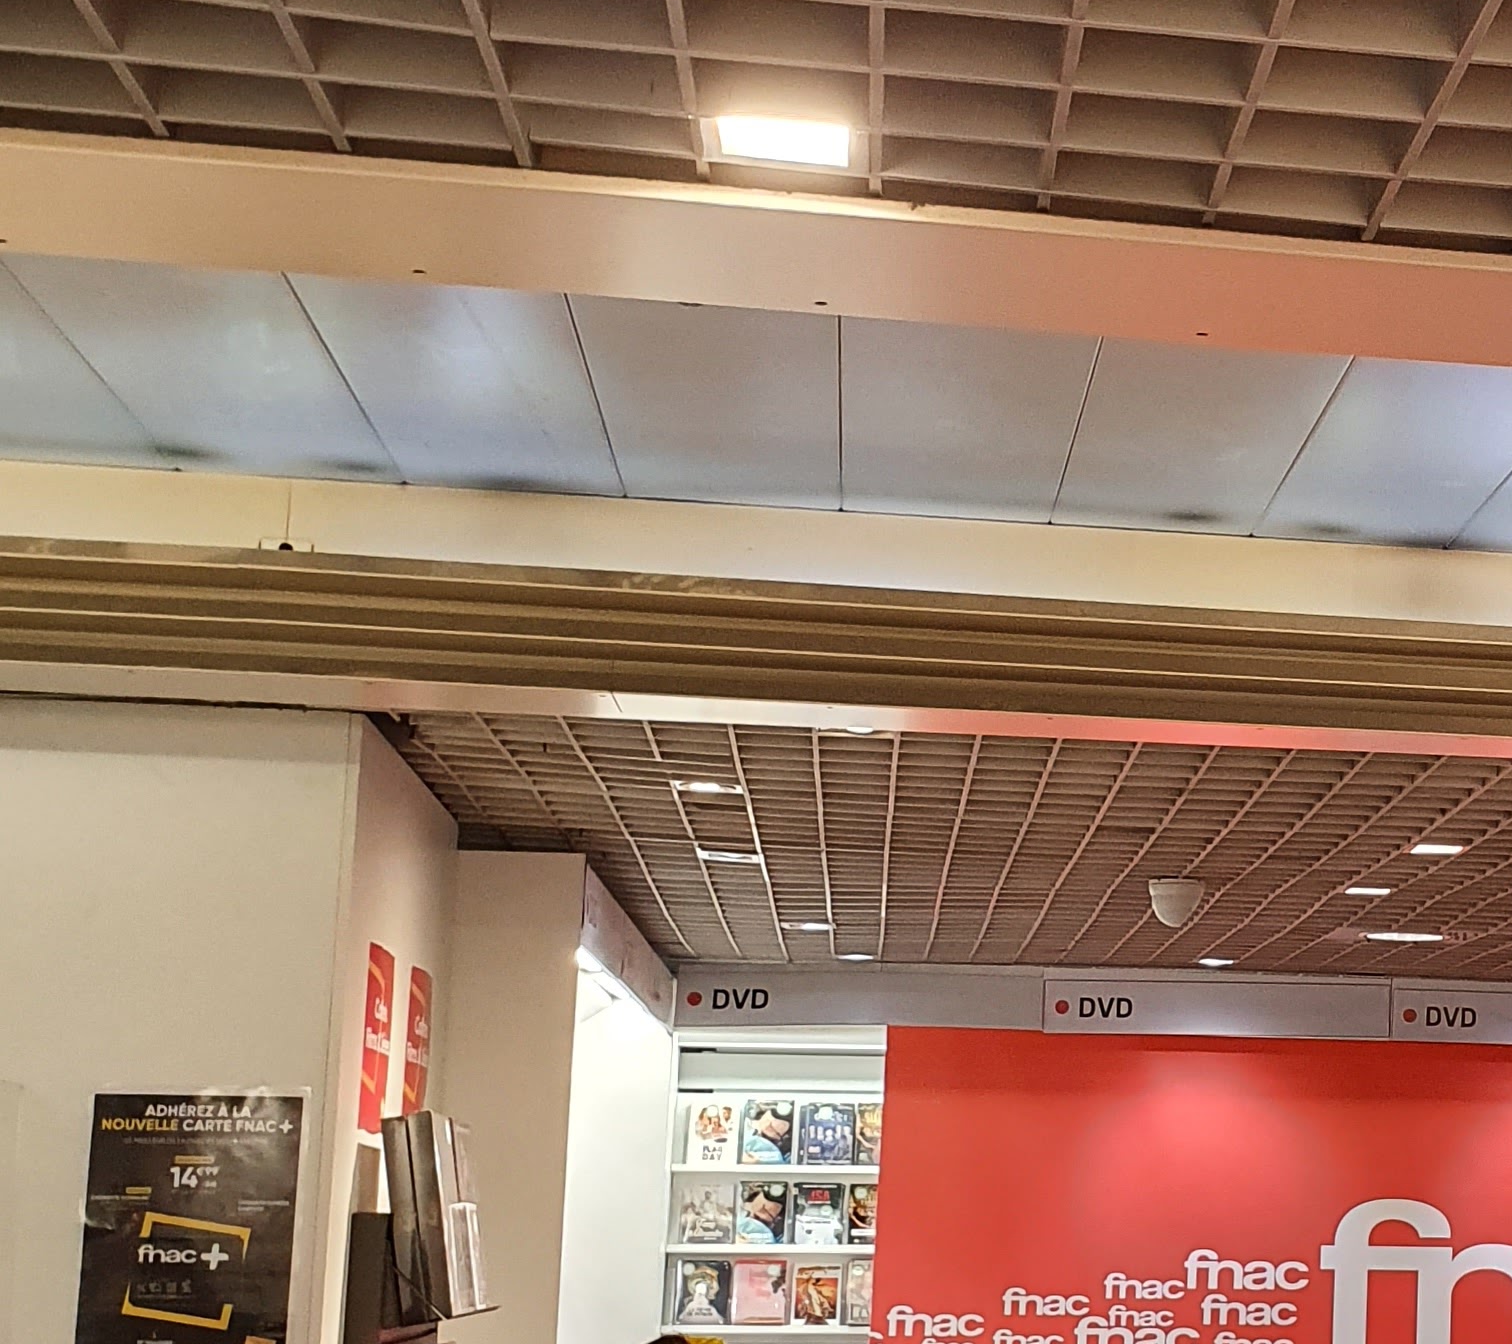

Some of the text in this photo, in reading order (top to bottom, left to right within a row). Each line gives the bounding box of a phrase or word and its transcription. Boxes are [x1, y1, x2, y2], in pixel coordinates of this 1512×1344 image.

[712, 988, 769, 1009] DVD
[1079, 997, 1133, 1018] DVD
[1425, 1006, 1477, 1029] DVD
[145, 1104, 214, 1118] ADHÉREZ
[233, 1105, 251, 1118] LA
[101, 1118, 178, 1132] NOUVELLE
[183, 1119, 232, 1132] CARTE
[1184, 1248, 1309, 1291] fnac
[1104, 1272, 1185, 1300] fnac
[1002, 1287, 1090, 1317] fnac
[1201, 1294, 1297, 1327] fnac
[887, 1305, 985, 1338] fnac
[1108, 1305, 1174, 1327] fnac
